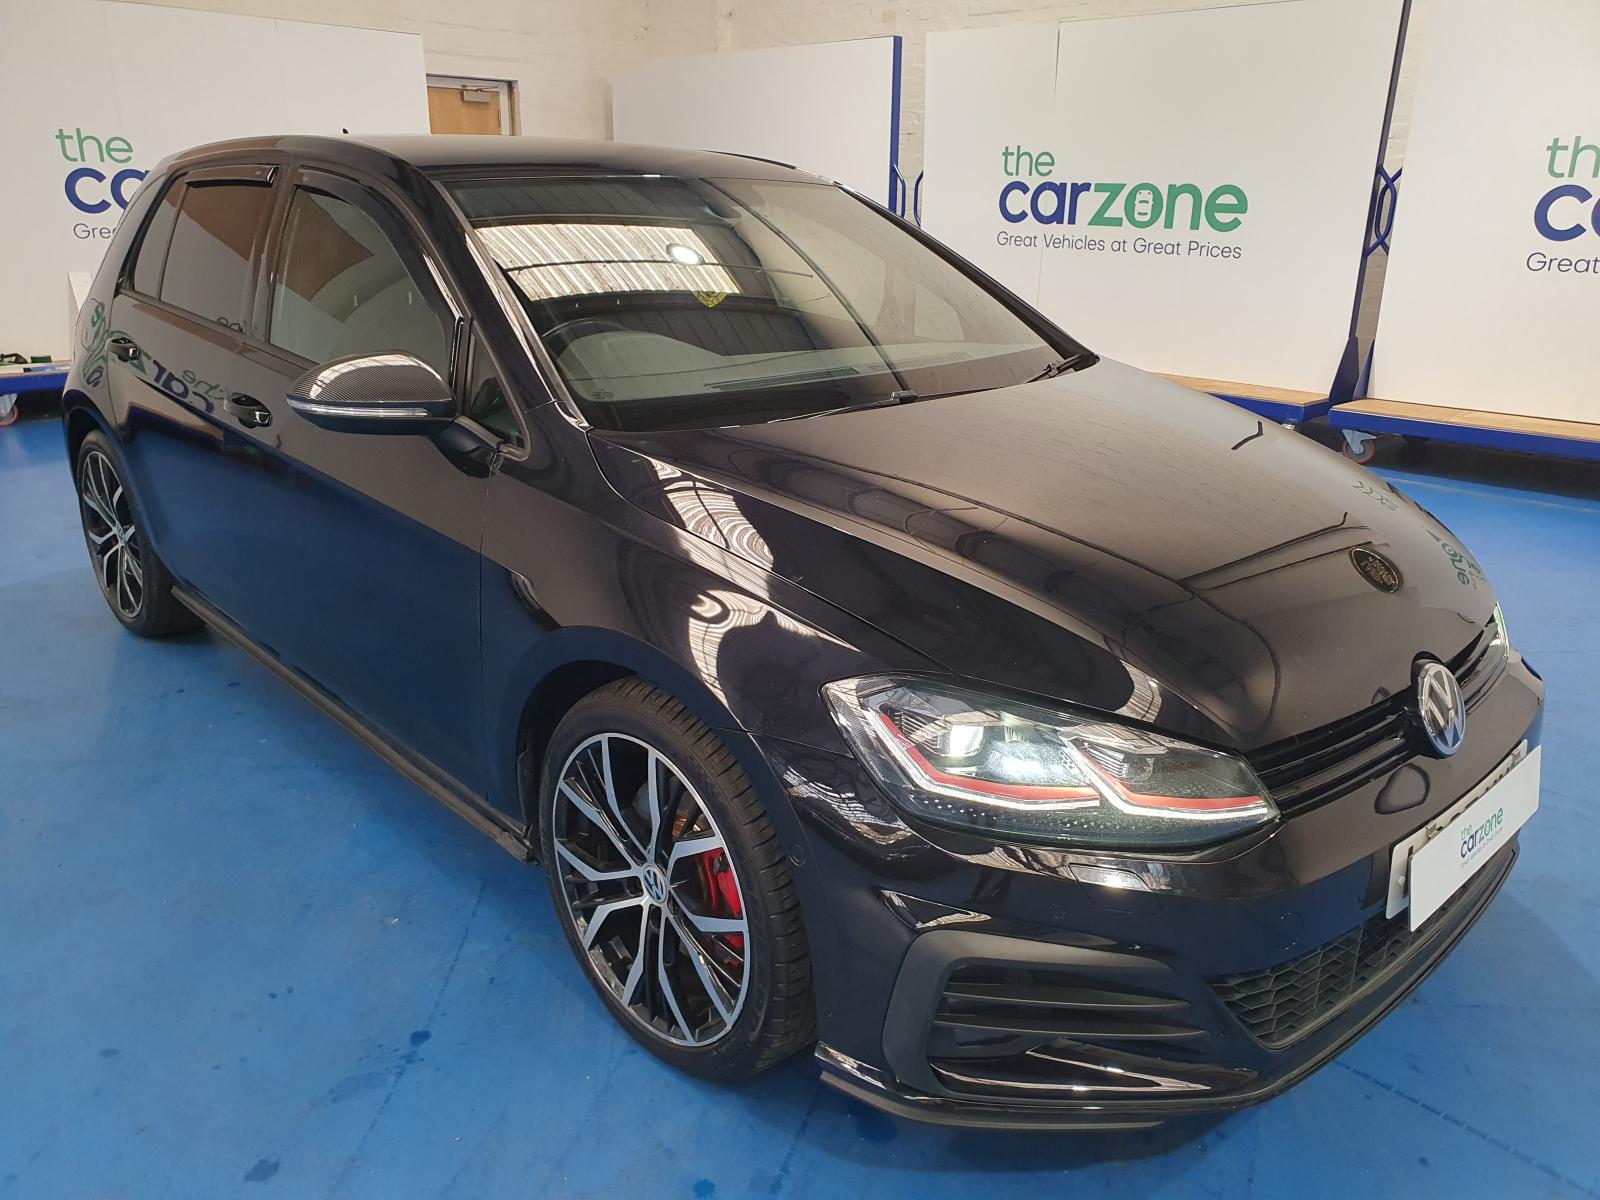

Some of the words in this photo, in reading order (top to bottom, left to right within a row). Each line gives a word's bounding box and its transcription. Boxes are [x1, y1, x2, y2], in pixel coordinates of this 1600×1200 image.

[55, 128, 133, 163] the
[1002, 145, 1055, 177] the
[999, 180, 1248, 232] carzone
[1534, 184, 1600, 241] c
[73, 223, 117, 240] Gre
[996, 230, 1038, 247] Great
[1043, 233, 1105, 251] Vehicles
[1111, 238, 1127, 252] at
[1133, 237, 1181, 255] Great
[1188, 240, 1242, 259] Prices
[1460, 808, 1503, 858] carzone
